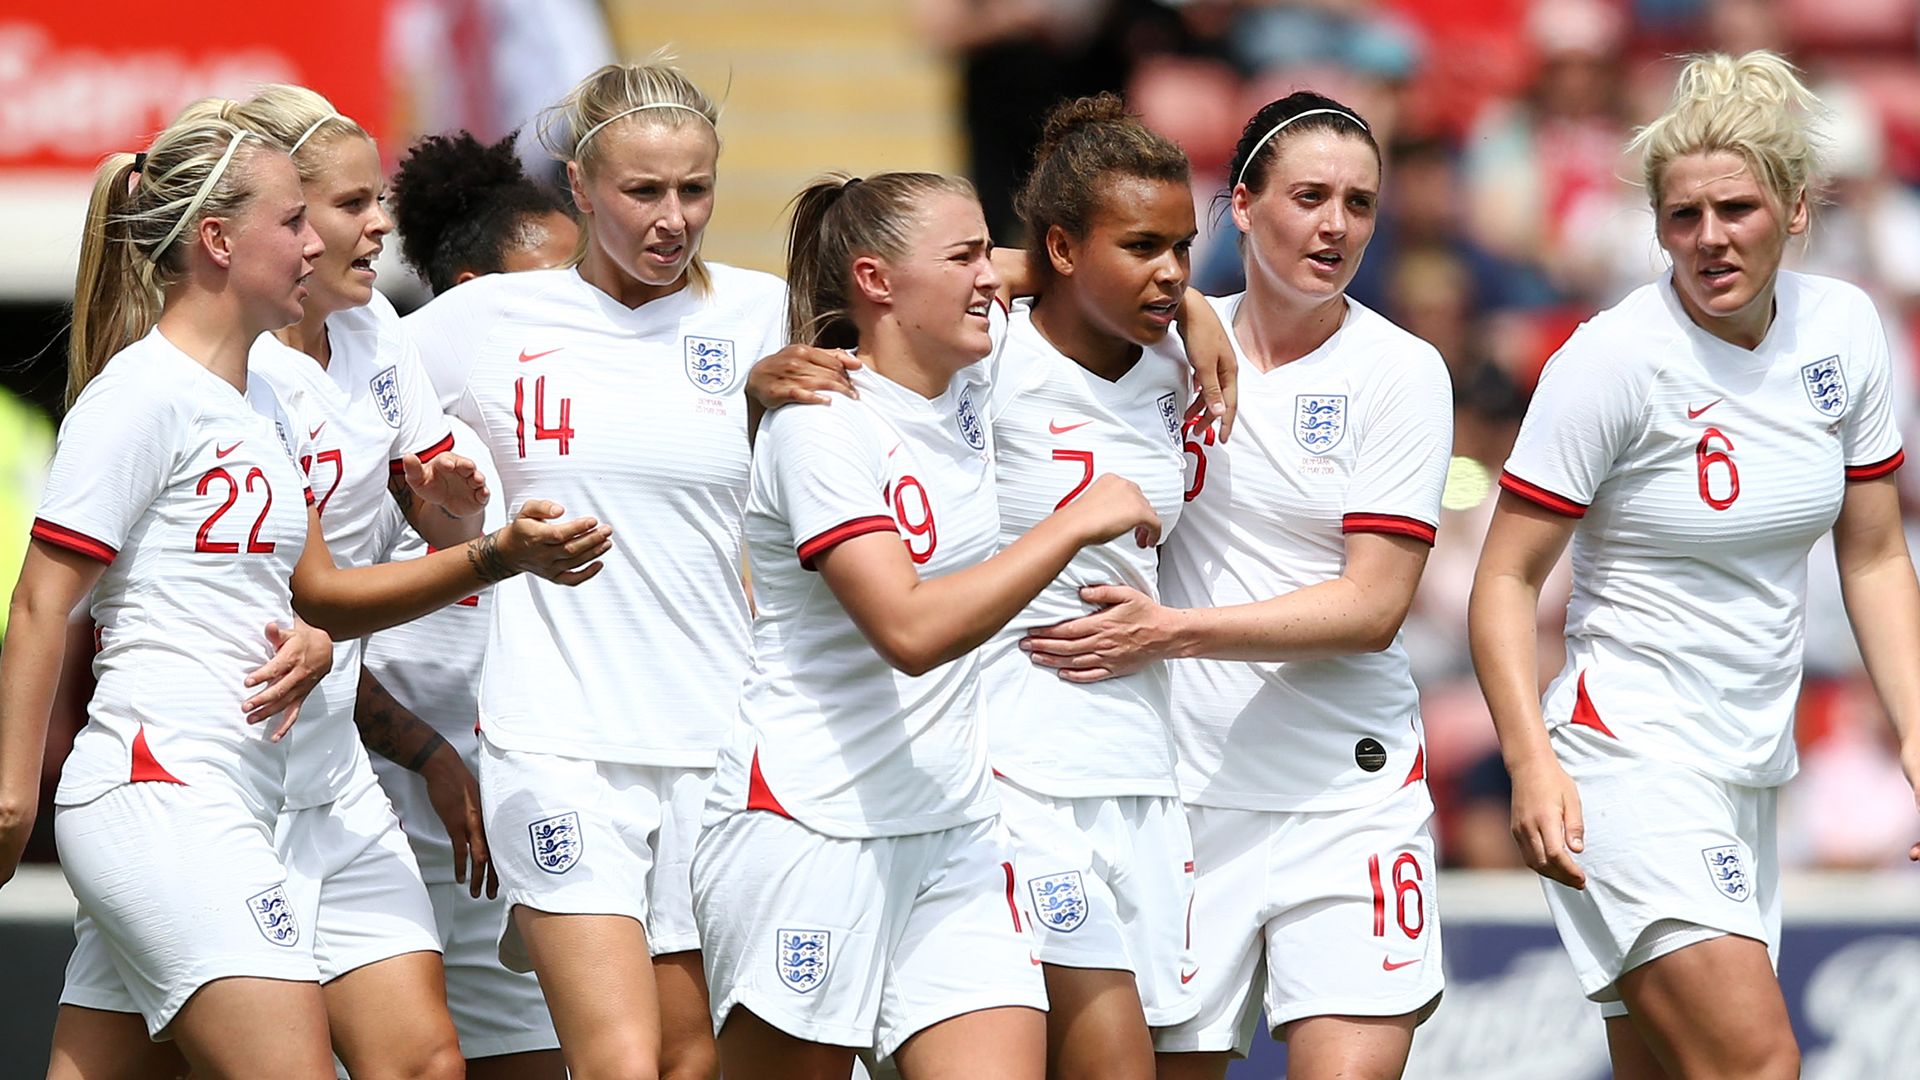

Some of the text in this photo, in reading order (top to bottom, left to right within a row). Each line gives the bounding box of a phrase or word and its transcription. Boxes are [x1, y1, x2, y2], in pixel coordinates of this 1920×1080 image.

[514, 375, 574, 458] 14
[195, 467, 276, 554] 22
[301, 449, 343, 518] 7
[1052, 449, 1094, 512] 7
[1696, 427, 1740, 511] 6
[884, 475, 937, 564] 9
[1368, 852, 1424, 940] 16
